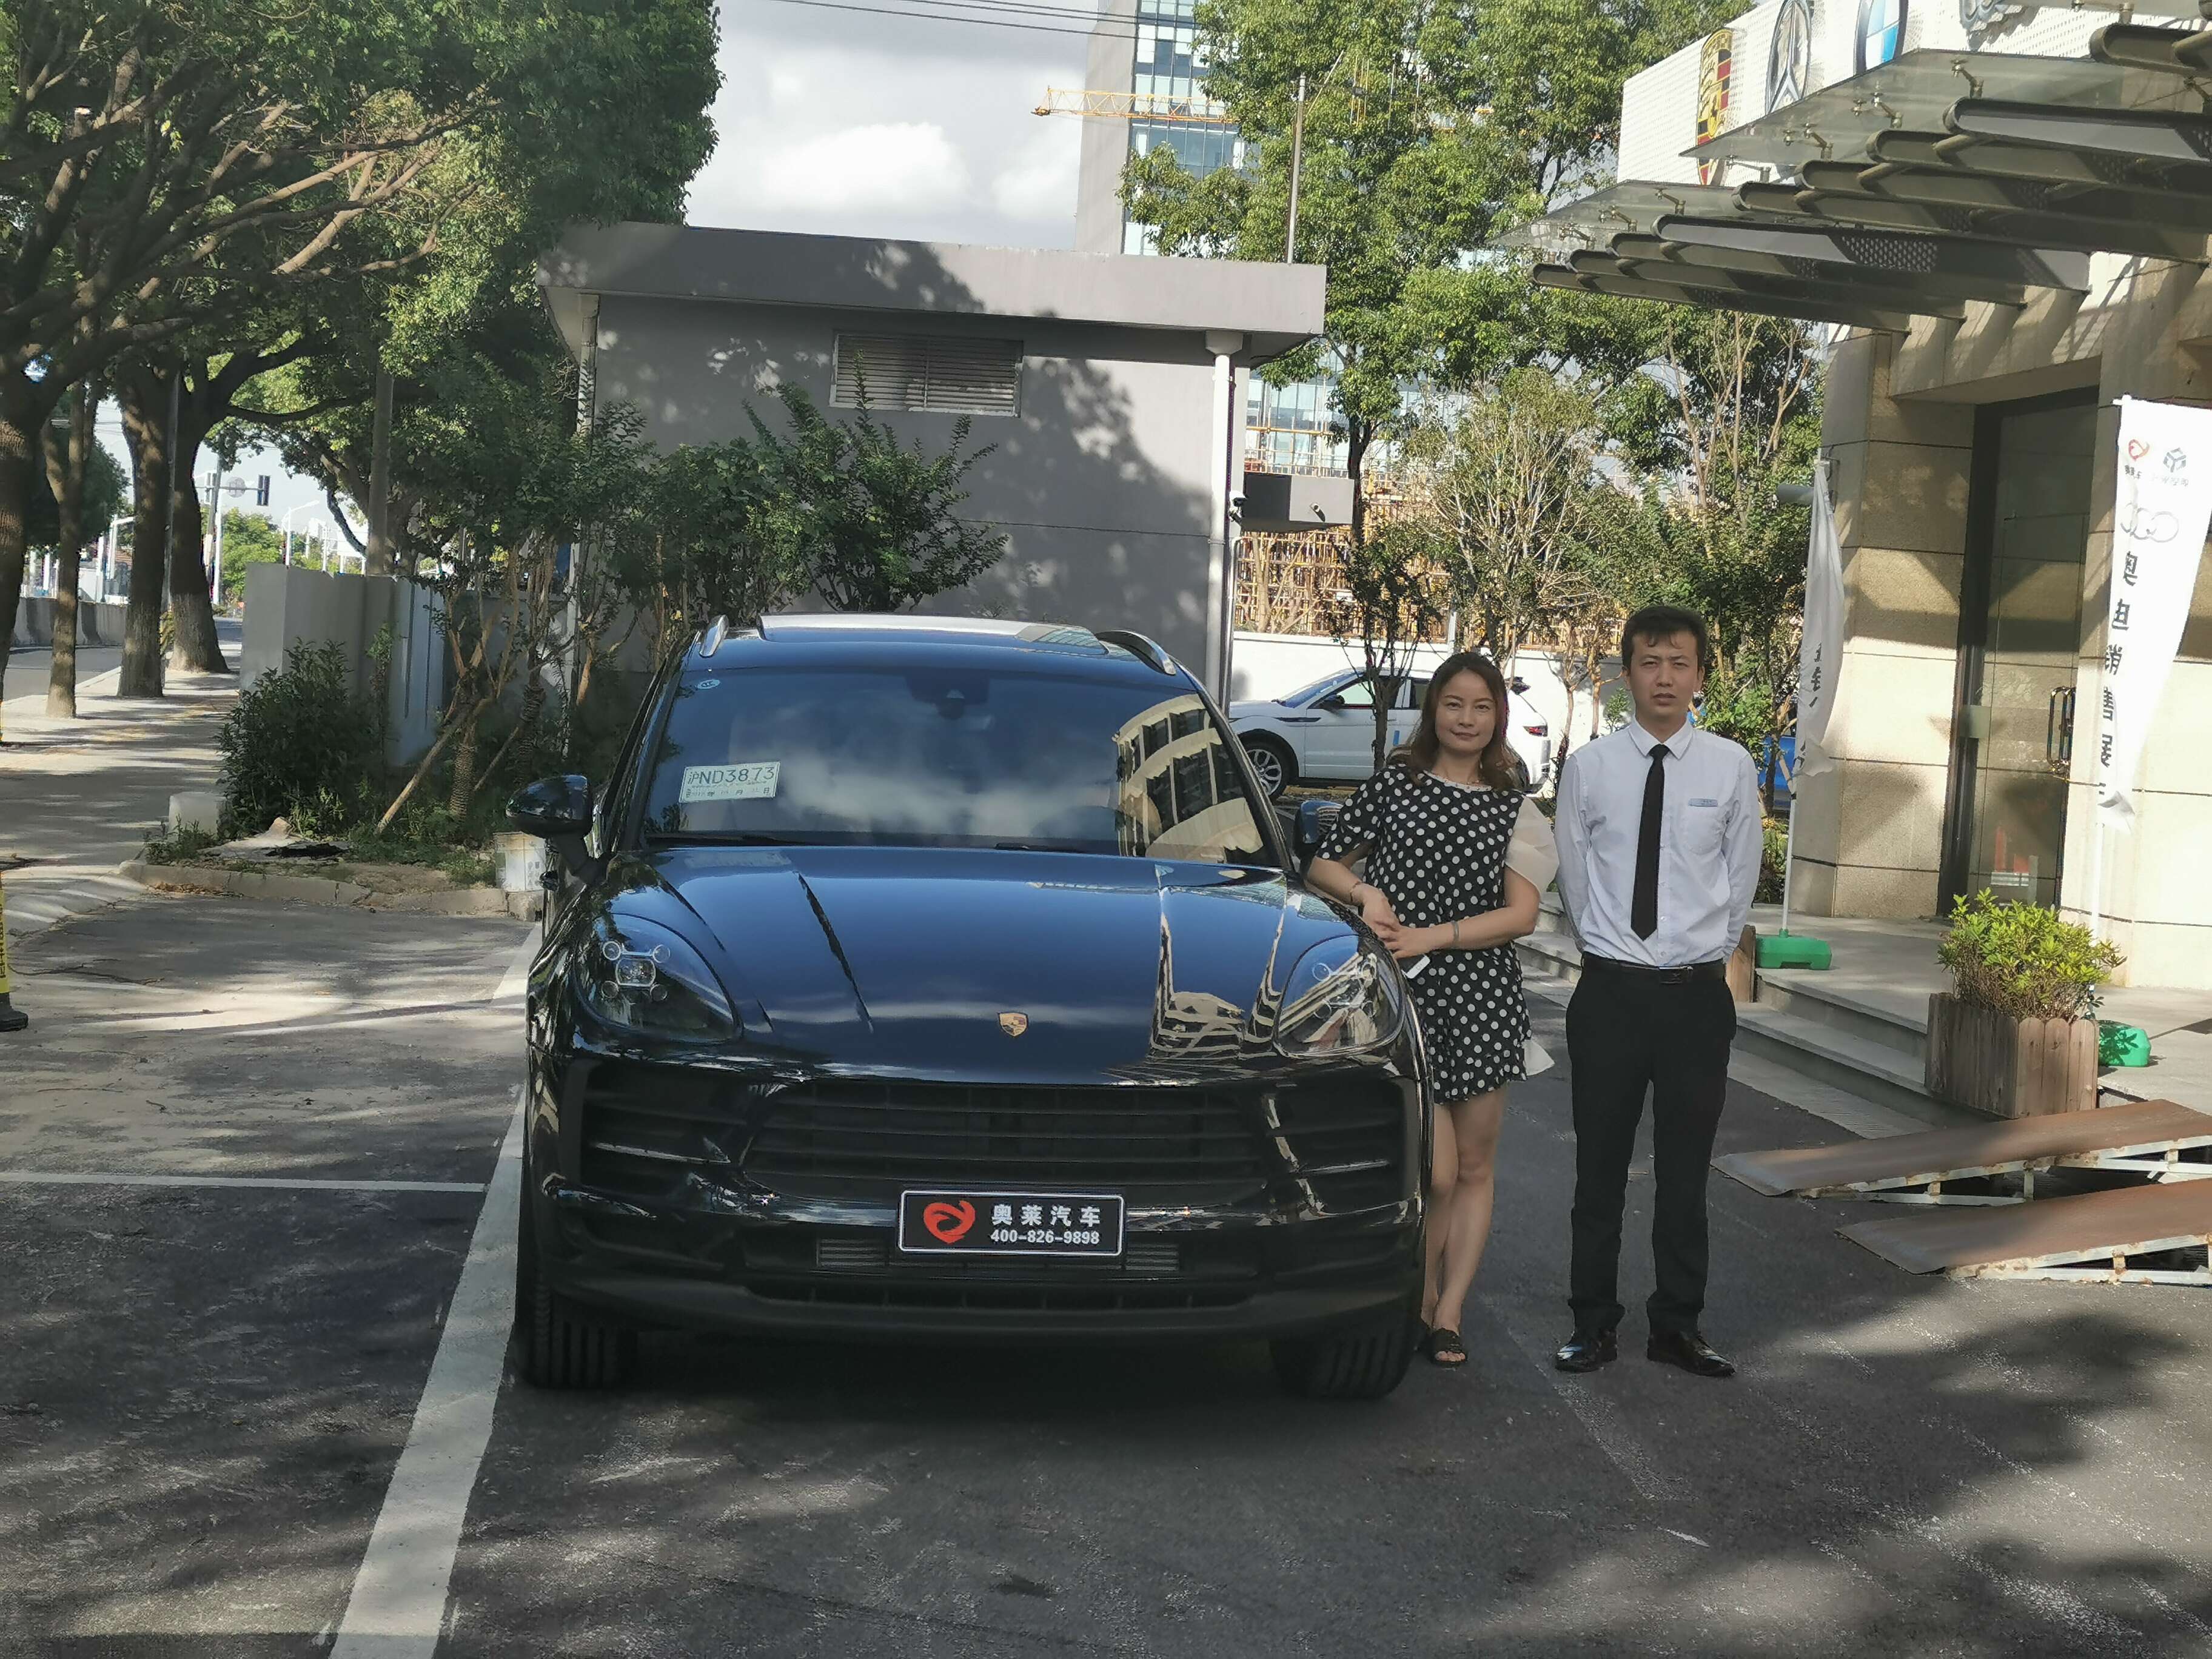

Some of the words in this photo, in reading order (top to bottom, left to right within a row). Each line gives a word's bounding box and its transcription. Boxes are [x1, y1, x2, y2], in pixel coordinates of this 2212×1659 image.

[991, 1204, 1101, 1228] 奥莱汽车
[990, 1230, 1100, 1245] 400-826-9898
